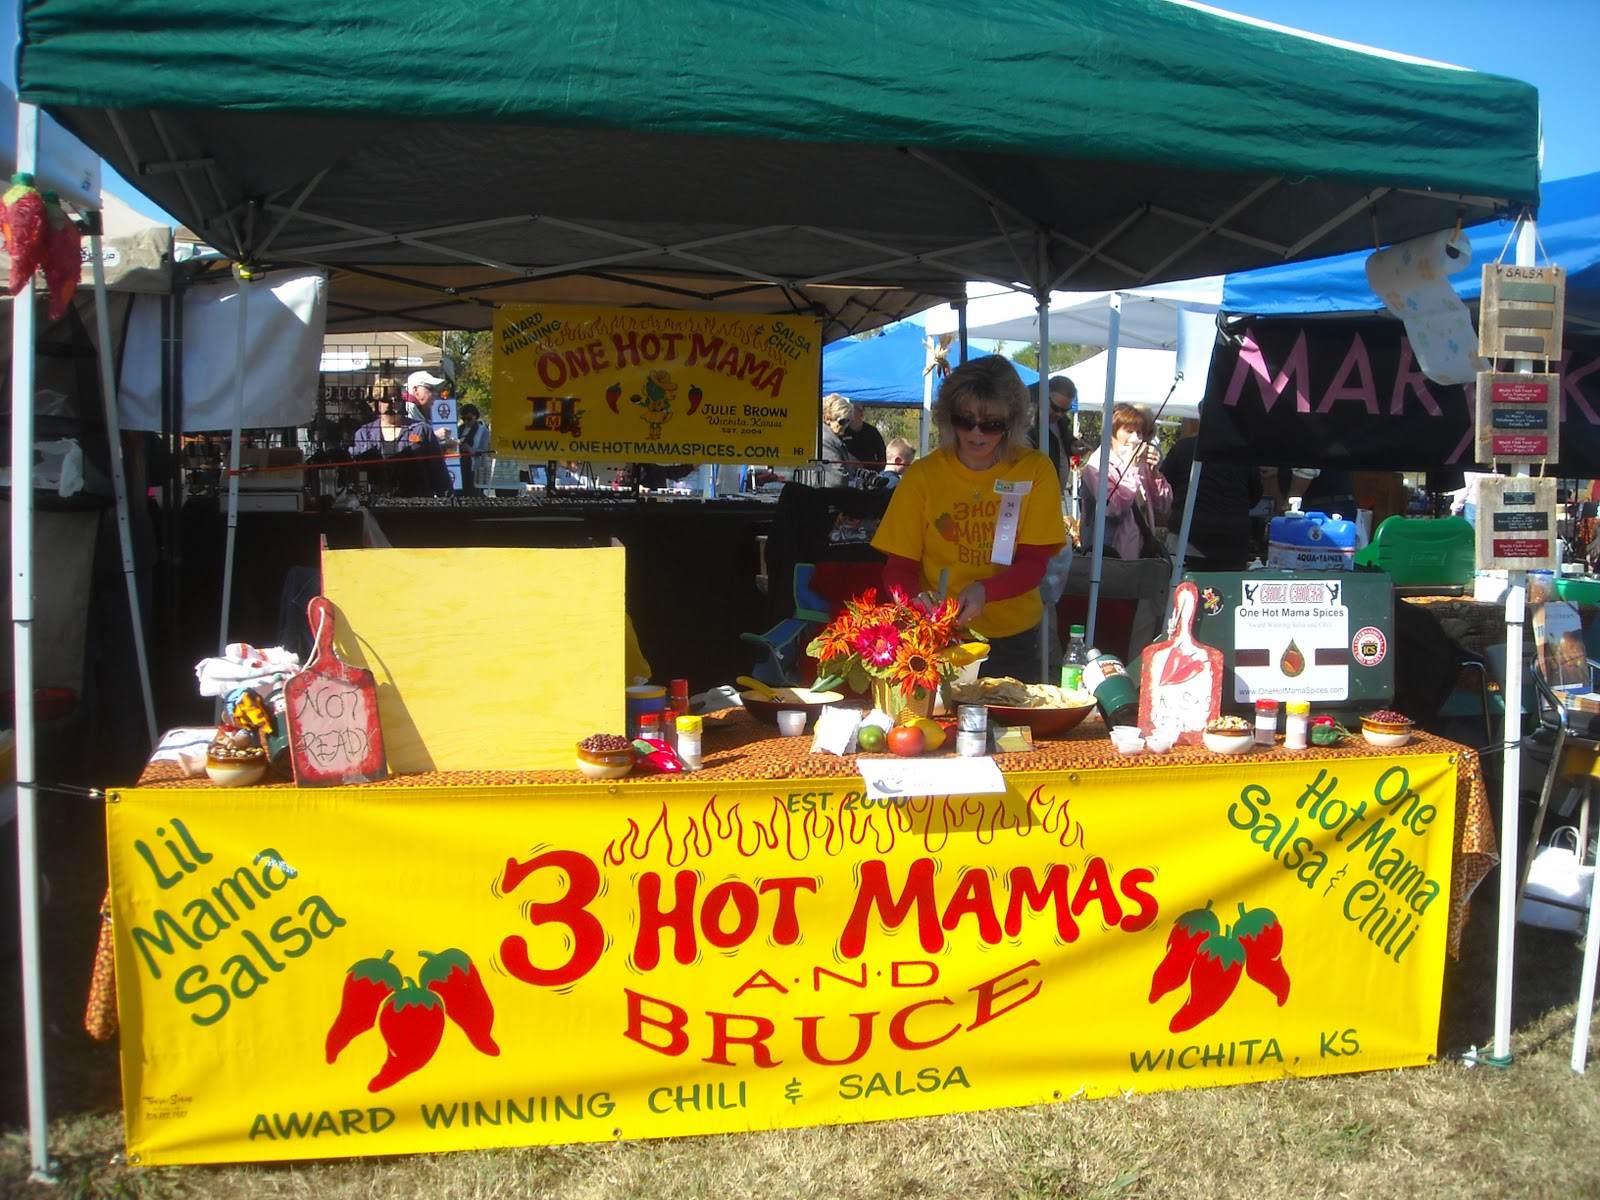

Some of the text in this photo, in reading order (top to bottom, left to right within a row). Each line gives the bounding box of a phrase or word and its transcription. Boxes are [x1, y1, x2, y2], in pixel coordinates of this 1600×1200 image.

[1506, 267, 1544, 279] SALSA
[501, 319, 562, 356] WINNING
[502, 312, 543, 341] AWARD
[771, 321, 812, 352] SALSA
[537, 330, 786, 398] ONE HOT MAMA
[768, 334, 801, 361] CHILI
[702, 403, 788, 418] JULIE BROWN
[1240, 607, 1344, 619] One Hot Mama Spices
[1363, 646, 1376, 654] ICS
[295, 686, 360, 720] NOT
[295, 727, 377, 768] READY
[787, 792, 834, 813] EST.
[1374, 766, 1437, 836] One
[134, 818, 214, 890] Lil
[1296, 768, 1440, 916] Hot Mama
[1228, 784, 1329, 889] Salsa
[1343, 880, 1420, 963] Chili
[131, 848, 298, 980] Mama
[500, 850, 1160, 986] 3 HOT MAMAS
[174, 895, 347, 1027] Salsa
[623, 959, 1043, 1069] BRUCE
[249, 1066, 972, 1142] AWARD WINNING CHILI & SALSA
